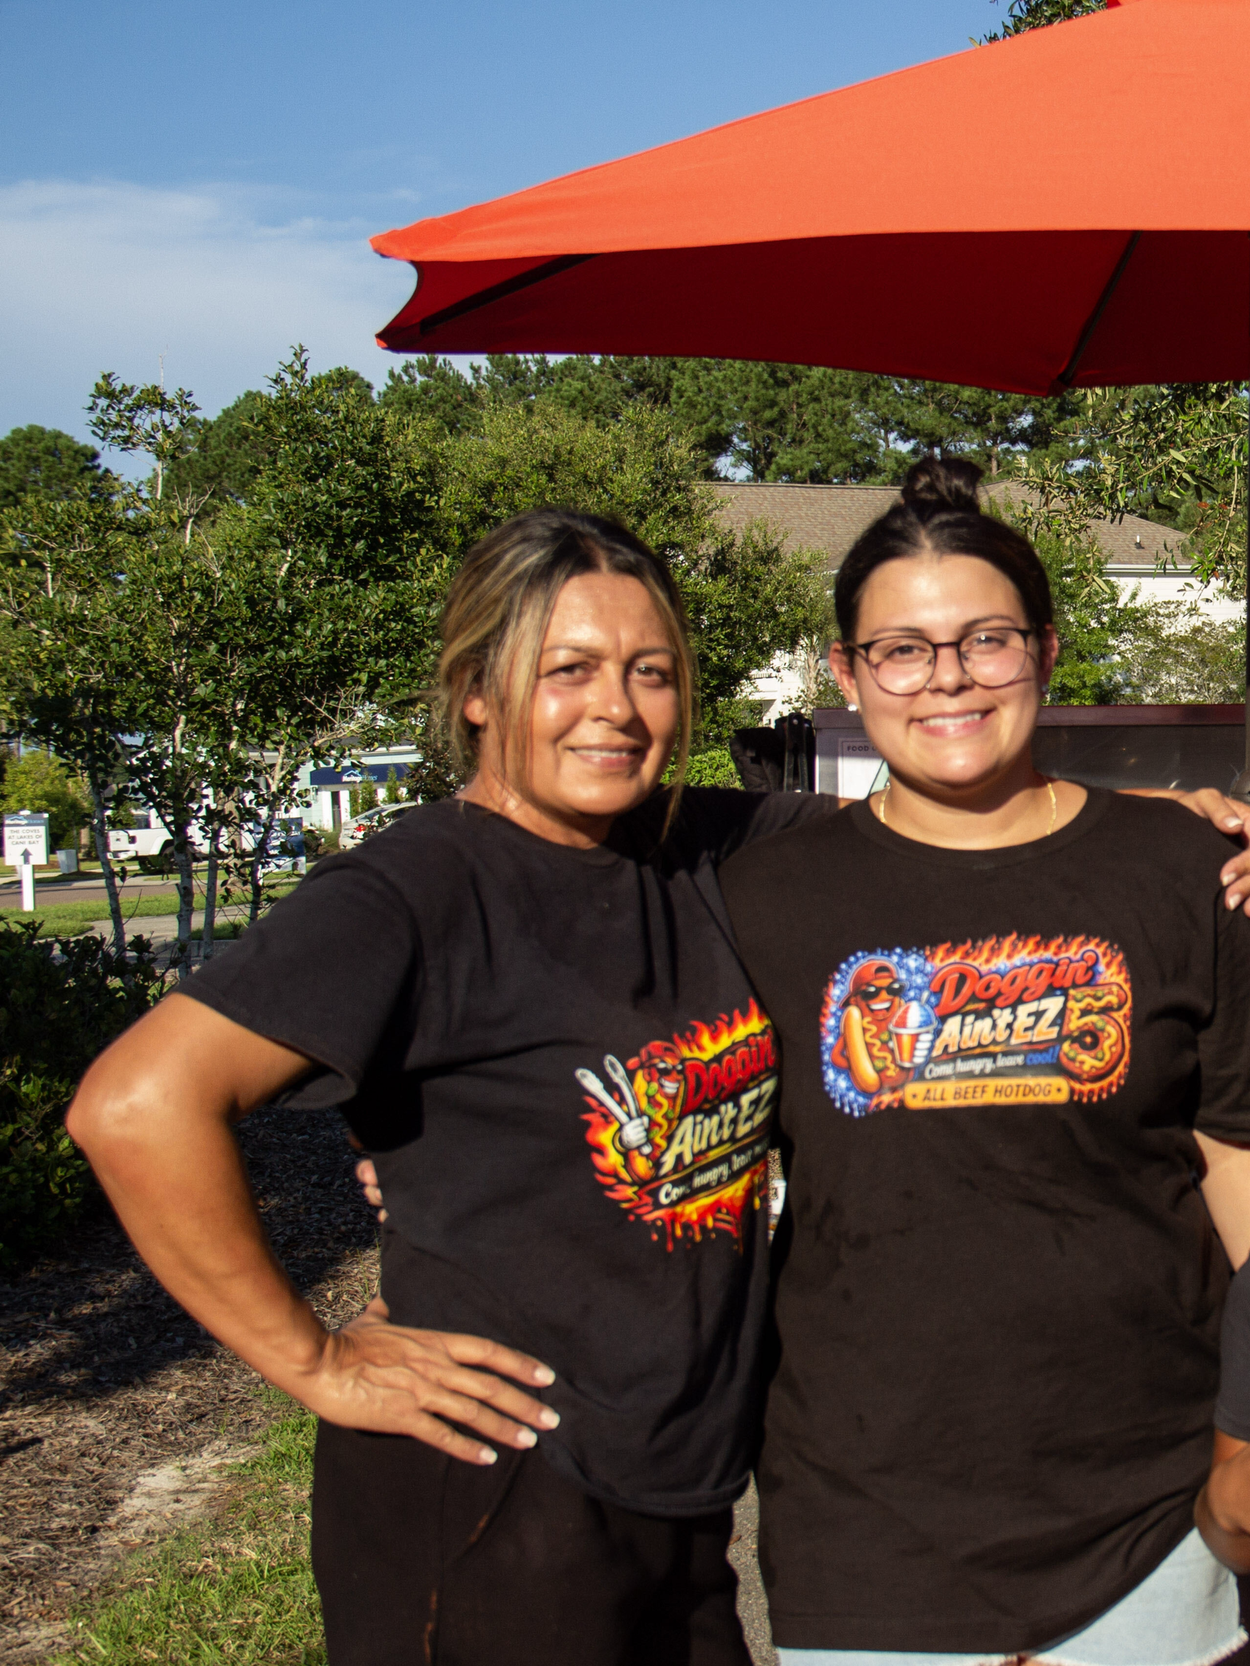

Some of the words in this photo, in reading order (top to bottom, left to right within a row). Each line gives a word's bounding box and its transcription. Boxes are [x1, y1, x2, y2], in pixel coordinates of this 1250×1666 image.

[929, 950, 1097, 1016] Doggin'
[1059, 981, 1131, 1083] 5
[924, 1062, 955, 1080] Come
[955, 1057, 995, 1075] hungry,
[996, 1053, 1025, 1068] leave
[1025, 1044, 1060, 1066] cool!
[922, 1088, 947, 1103] ALL
[952, 1085, 989, 1101] BEEF
[993, 1083, 1053, 1099] HOTDOG
